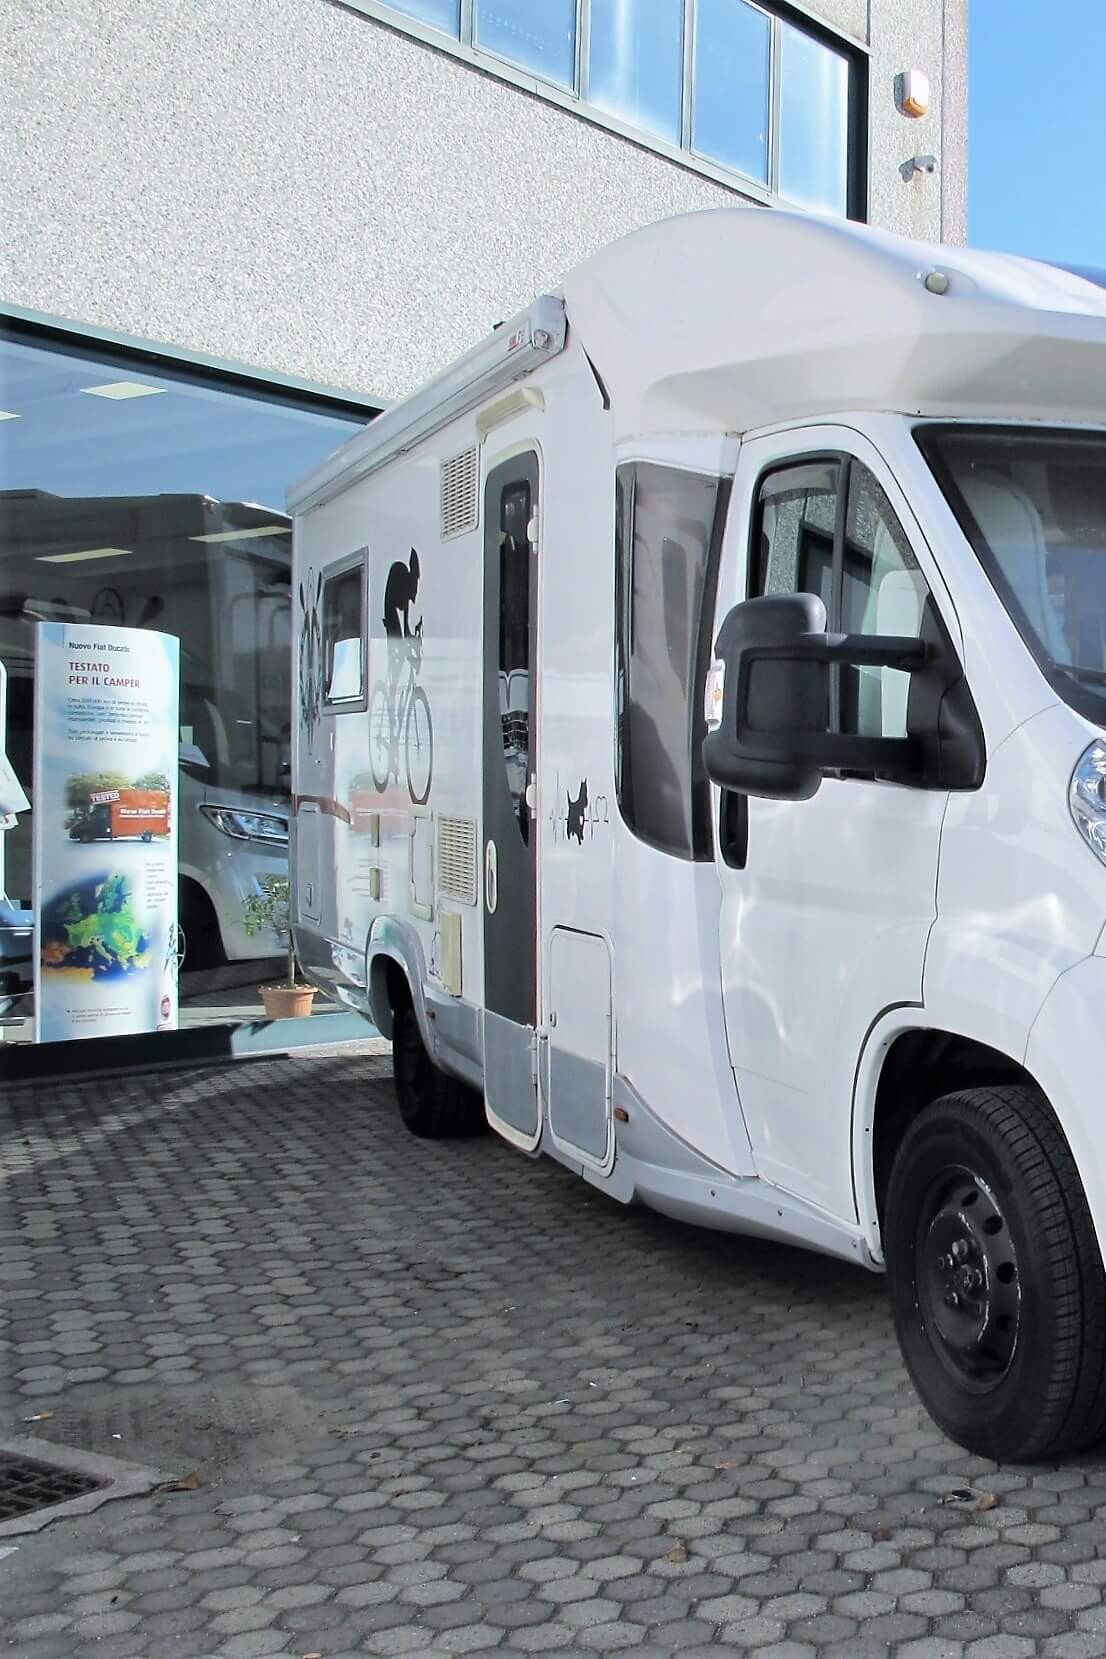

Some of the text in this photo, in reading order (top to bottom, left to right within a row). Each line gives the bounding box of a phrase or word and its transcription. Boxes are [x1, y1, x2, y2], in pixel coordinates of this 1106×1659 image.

[69, 642, 92, 650] Nuovo
[93, 643, 106, 651] Fiat
[69, 662, 110, 672] TESTATO
[69, 675, 140, 688] PER IL CAMPER
